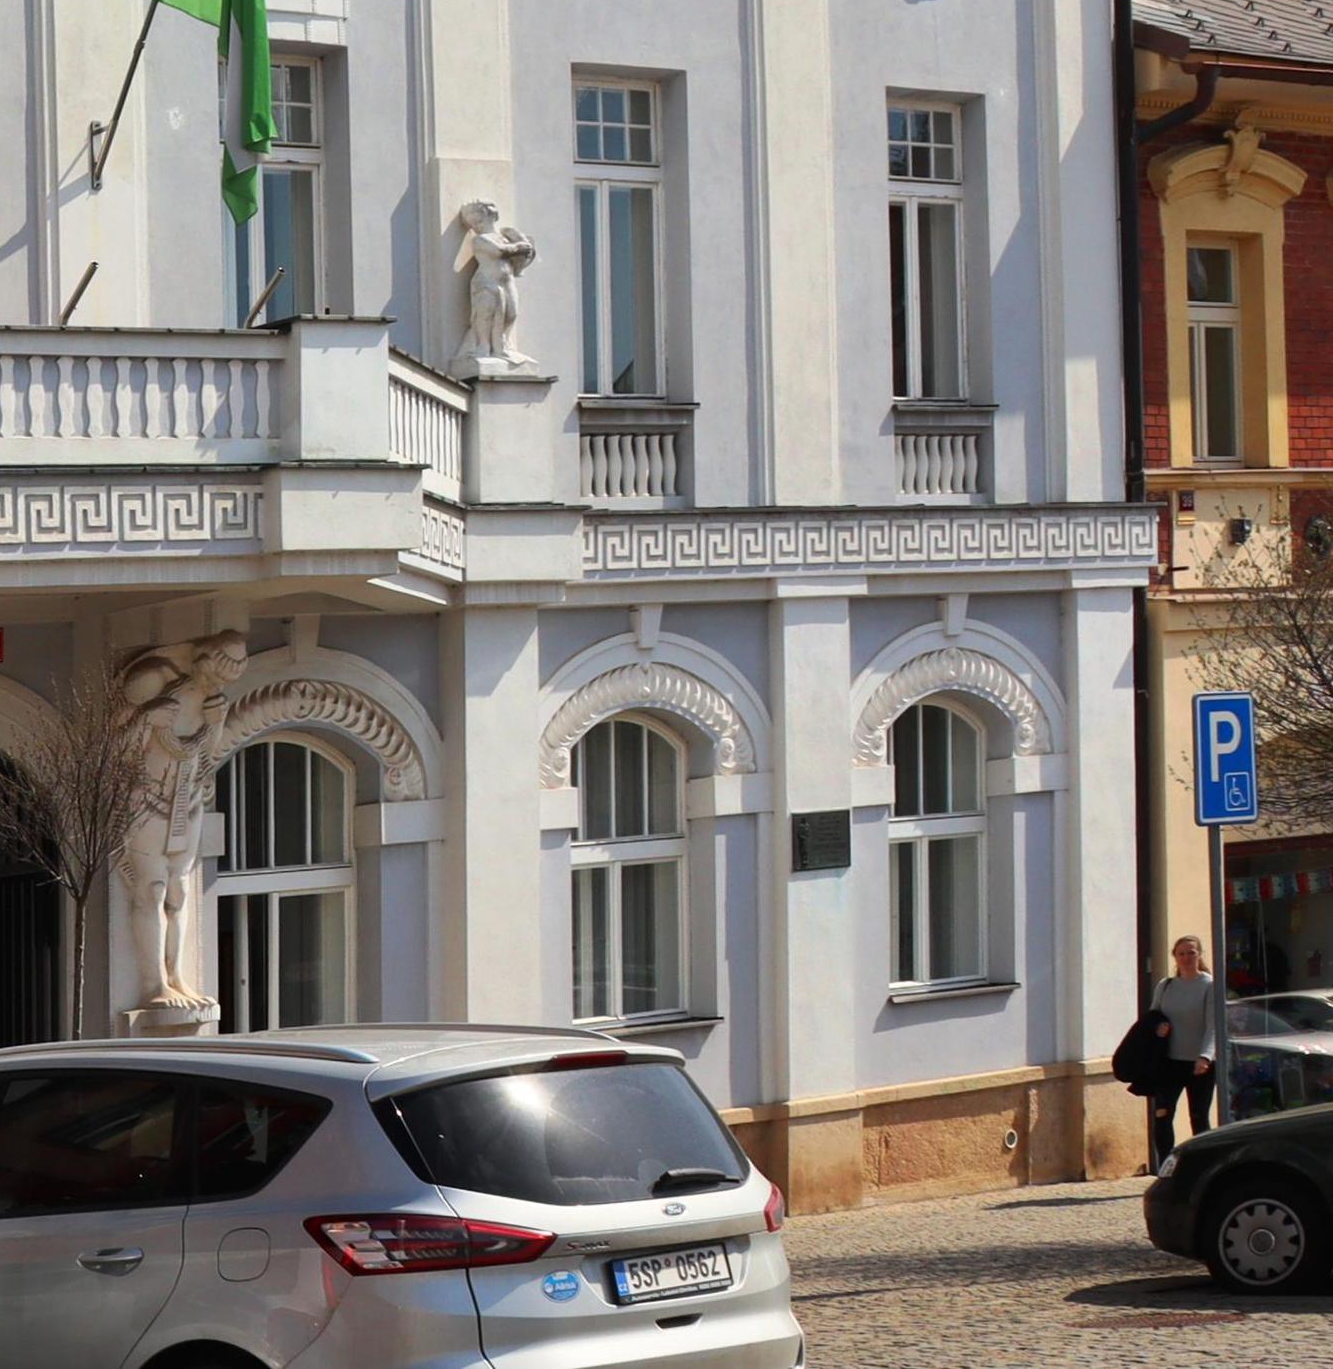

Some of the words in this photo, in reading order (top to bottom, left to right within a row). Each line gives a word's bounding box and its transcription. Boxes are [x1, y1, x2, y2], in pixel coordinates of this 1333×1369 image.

[1208, 710, 1242, 783] P
[628, 1260, 662, 1290] 5SP
[675, 1251, 721, 1281] 0562
